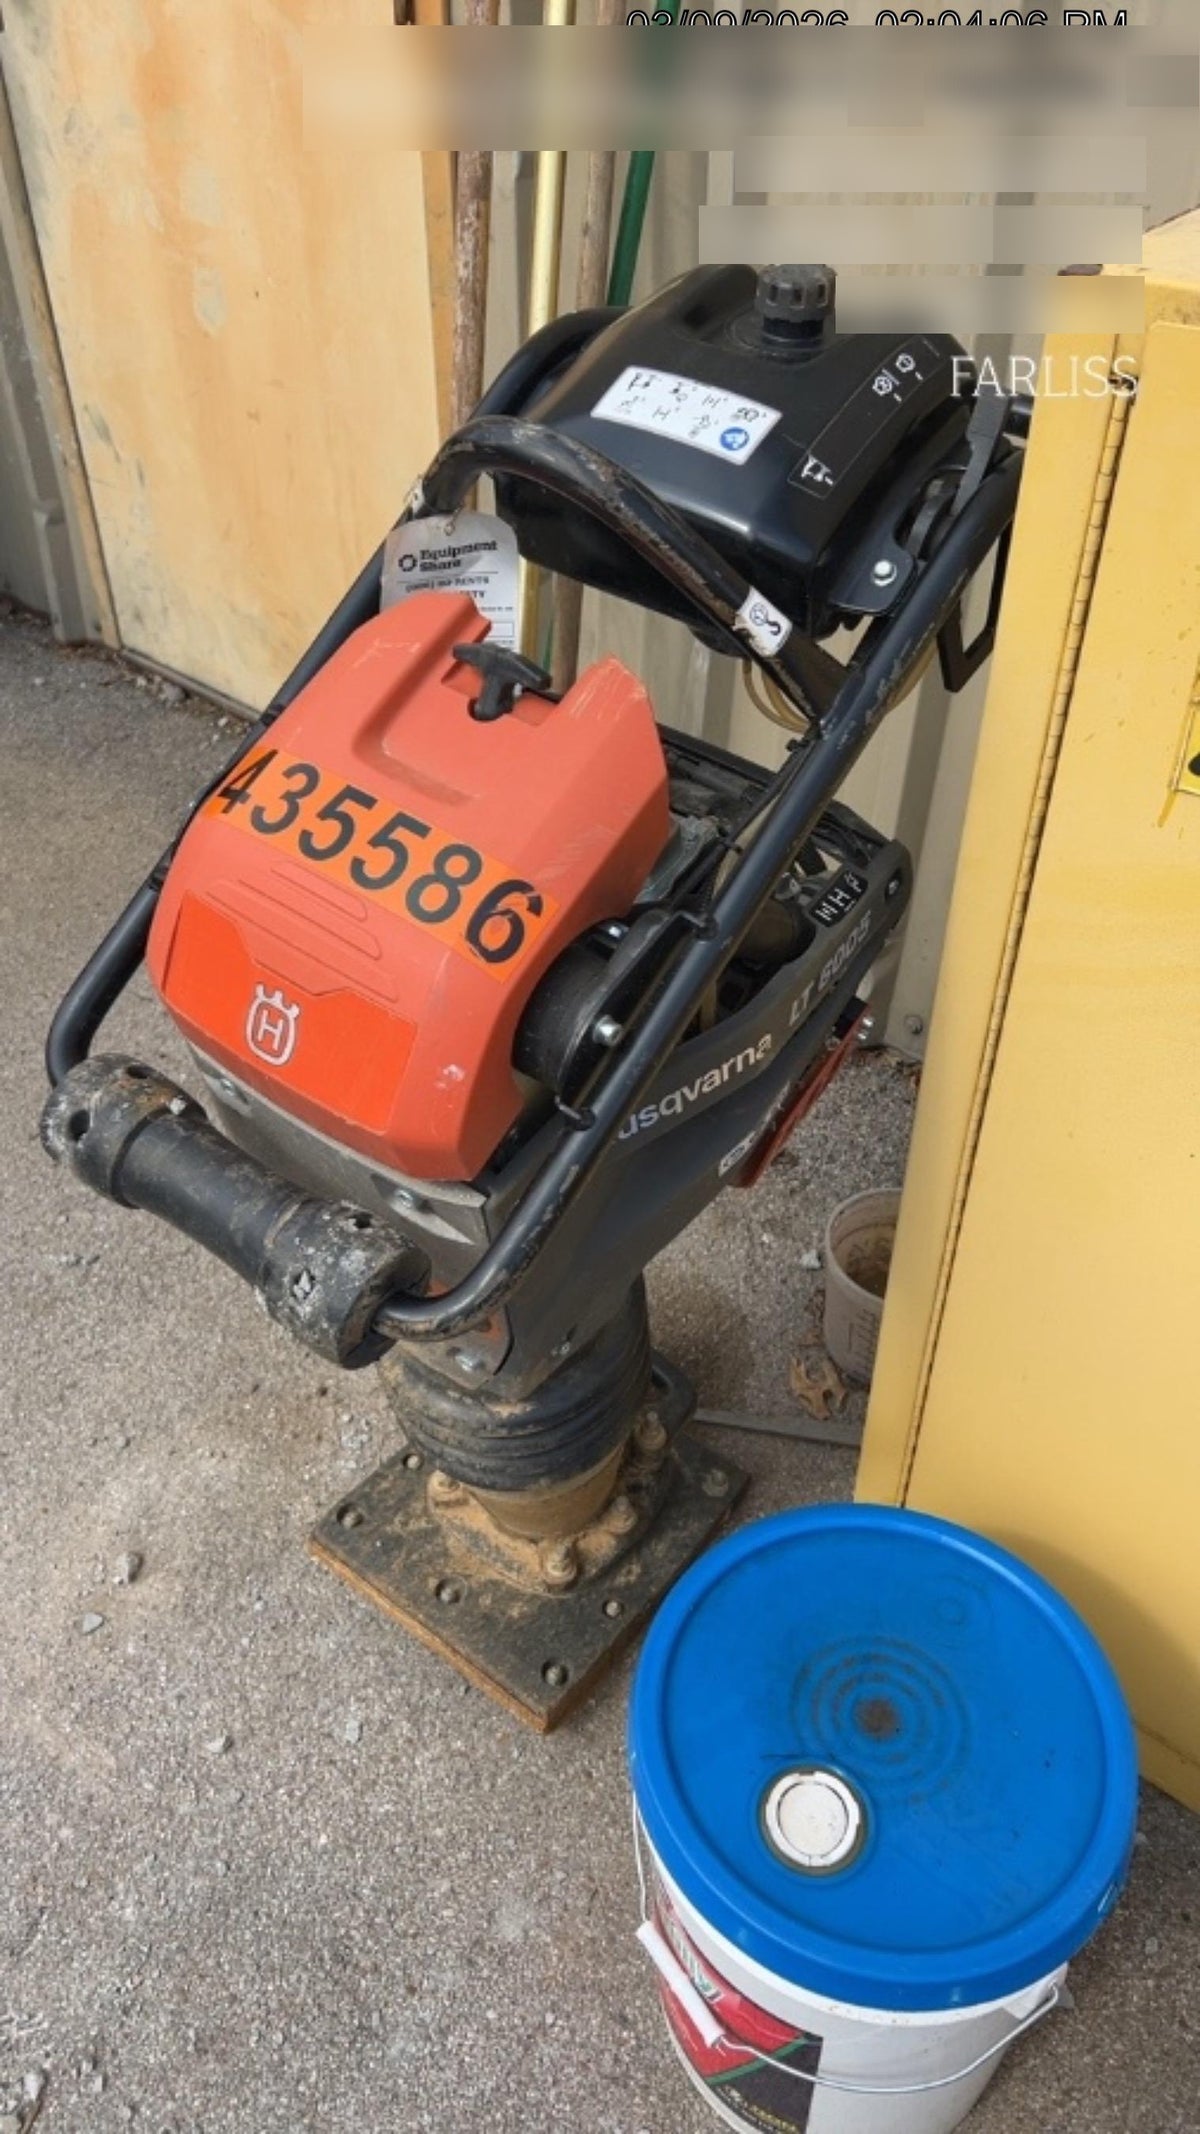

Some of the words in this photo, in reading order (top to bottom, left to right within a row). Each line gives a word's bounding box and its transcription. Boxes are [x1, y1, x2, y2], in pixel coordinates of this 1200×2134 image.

[420, 540, 498, 561] Equipment
[420, 559, 462, 572] Share
[217, 749, 545, 965] 435586
[618, 1033, 772, 1140] usqvarna
